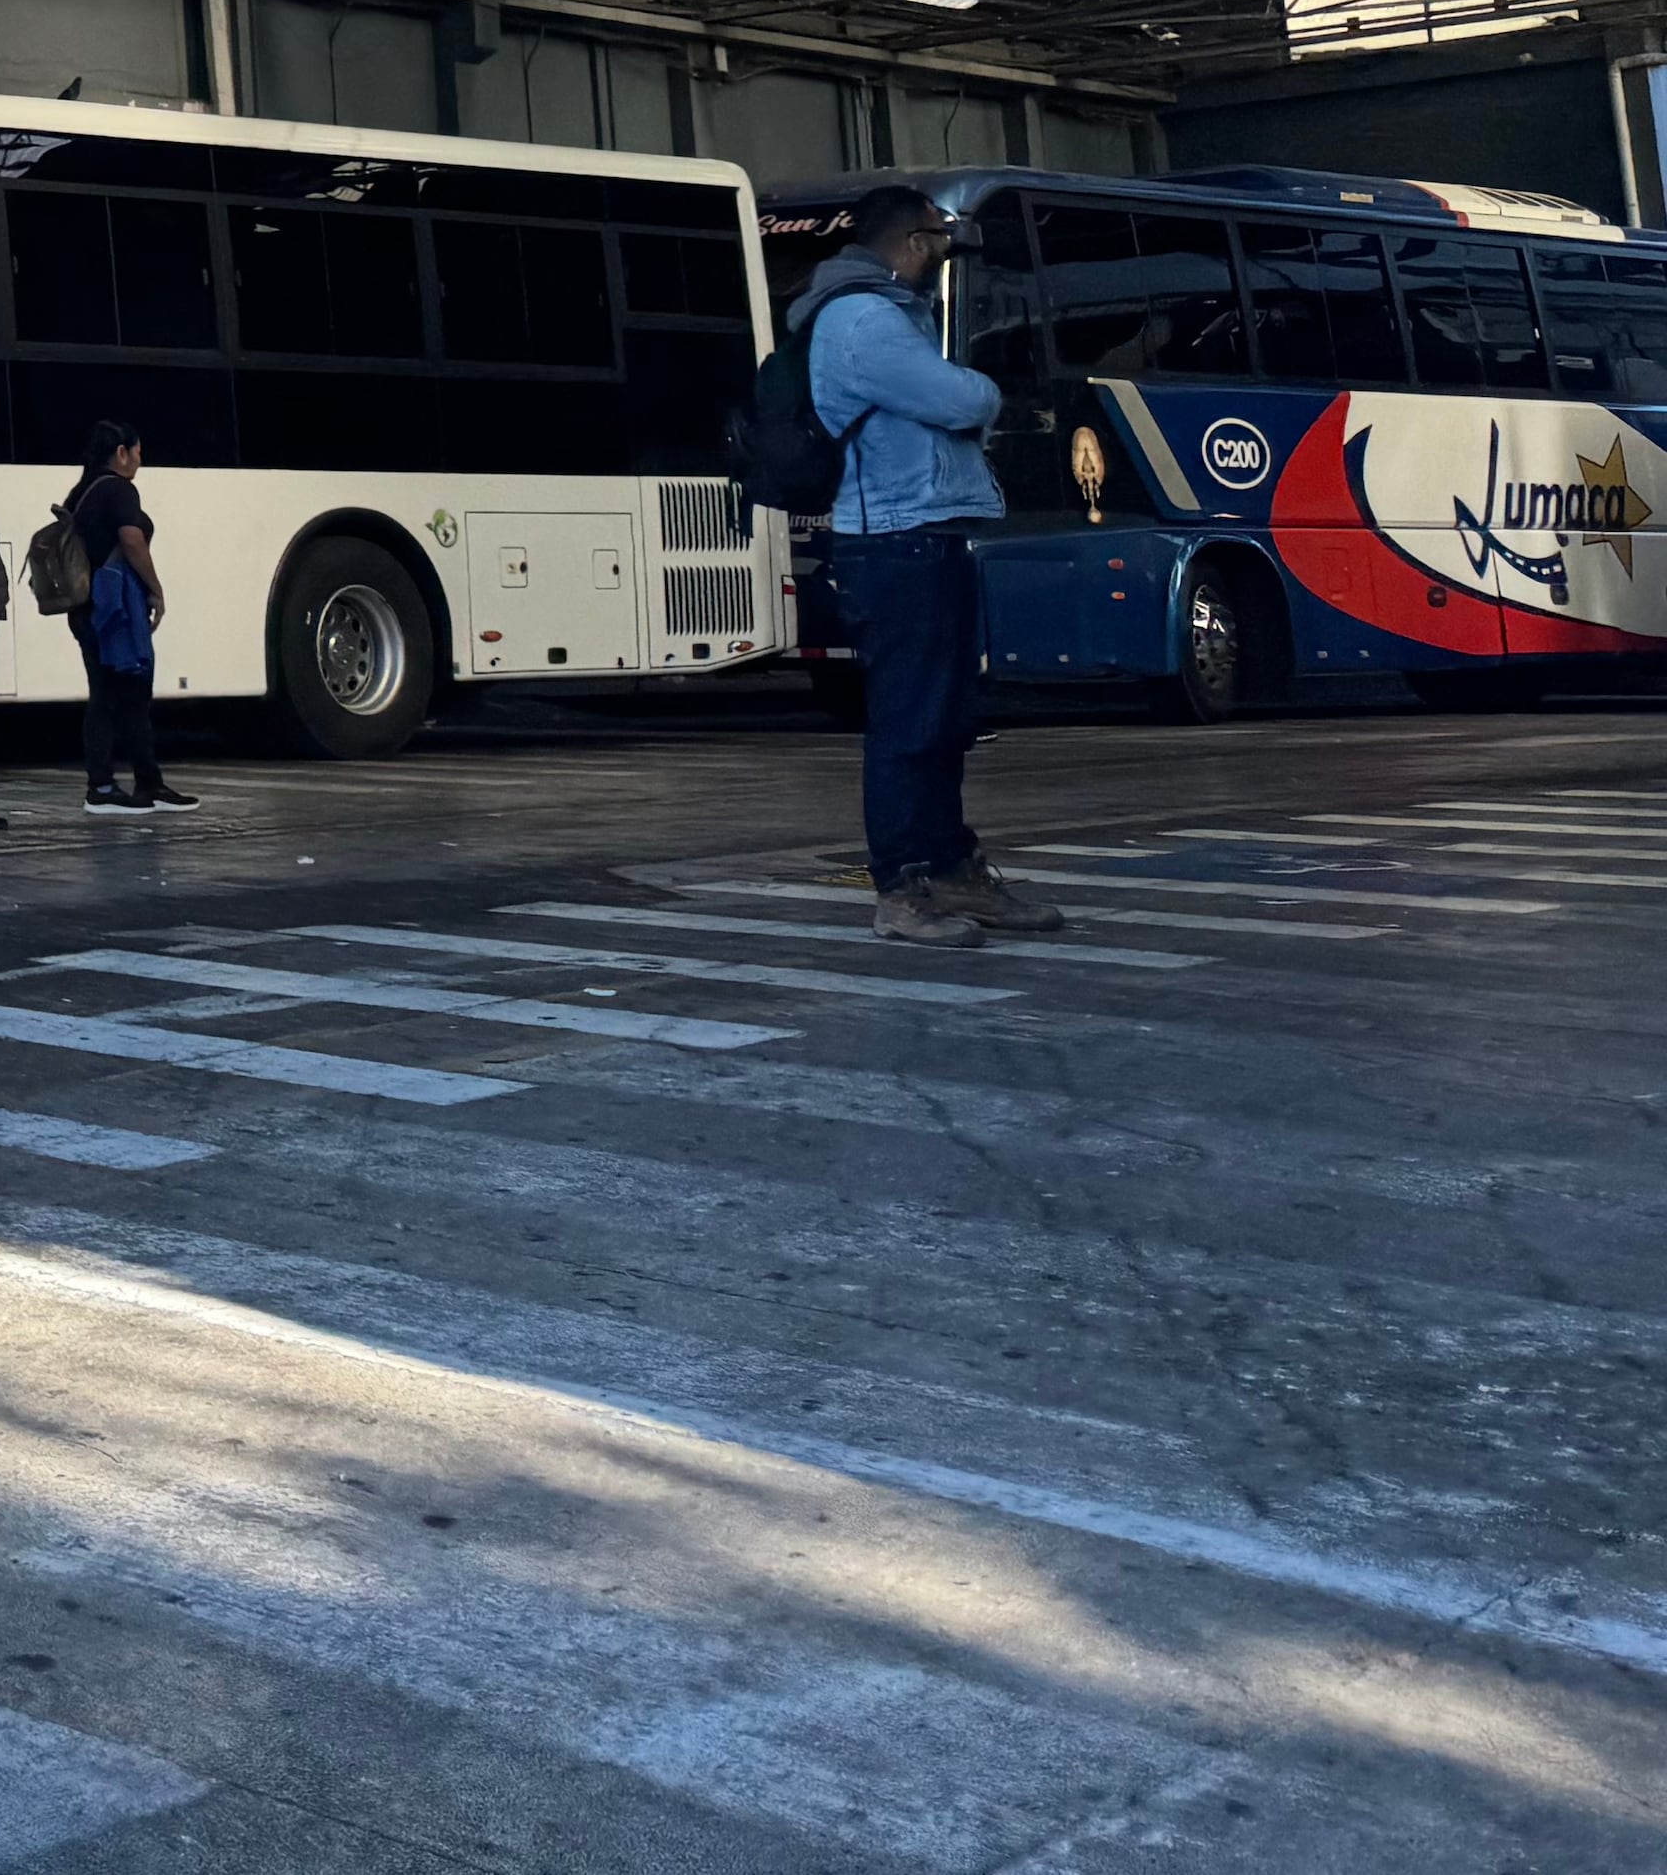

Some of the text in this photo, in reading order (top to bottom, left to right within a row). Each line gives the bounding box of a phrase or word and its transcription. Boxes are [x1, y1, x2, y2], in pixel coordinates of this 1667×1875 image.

[757, 214, 822, 237] San
[1212, 437, 1262, 470] C200
[1453, 417, 1627, 581] Lumaca
